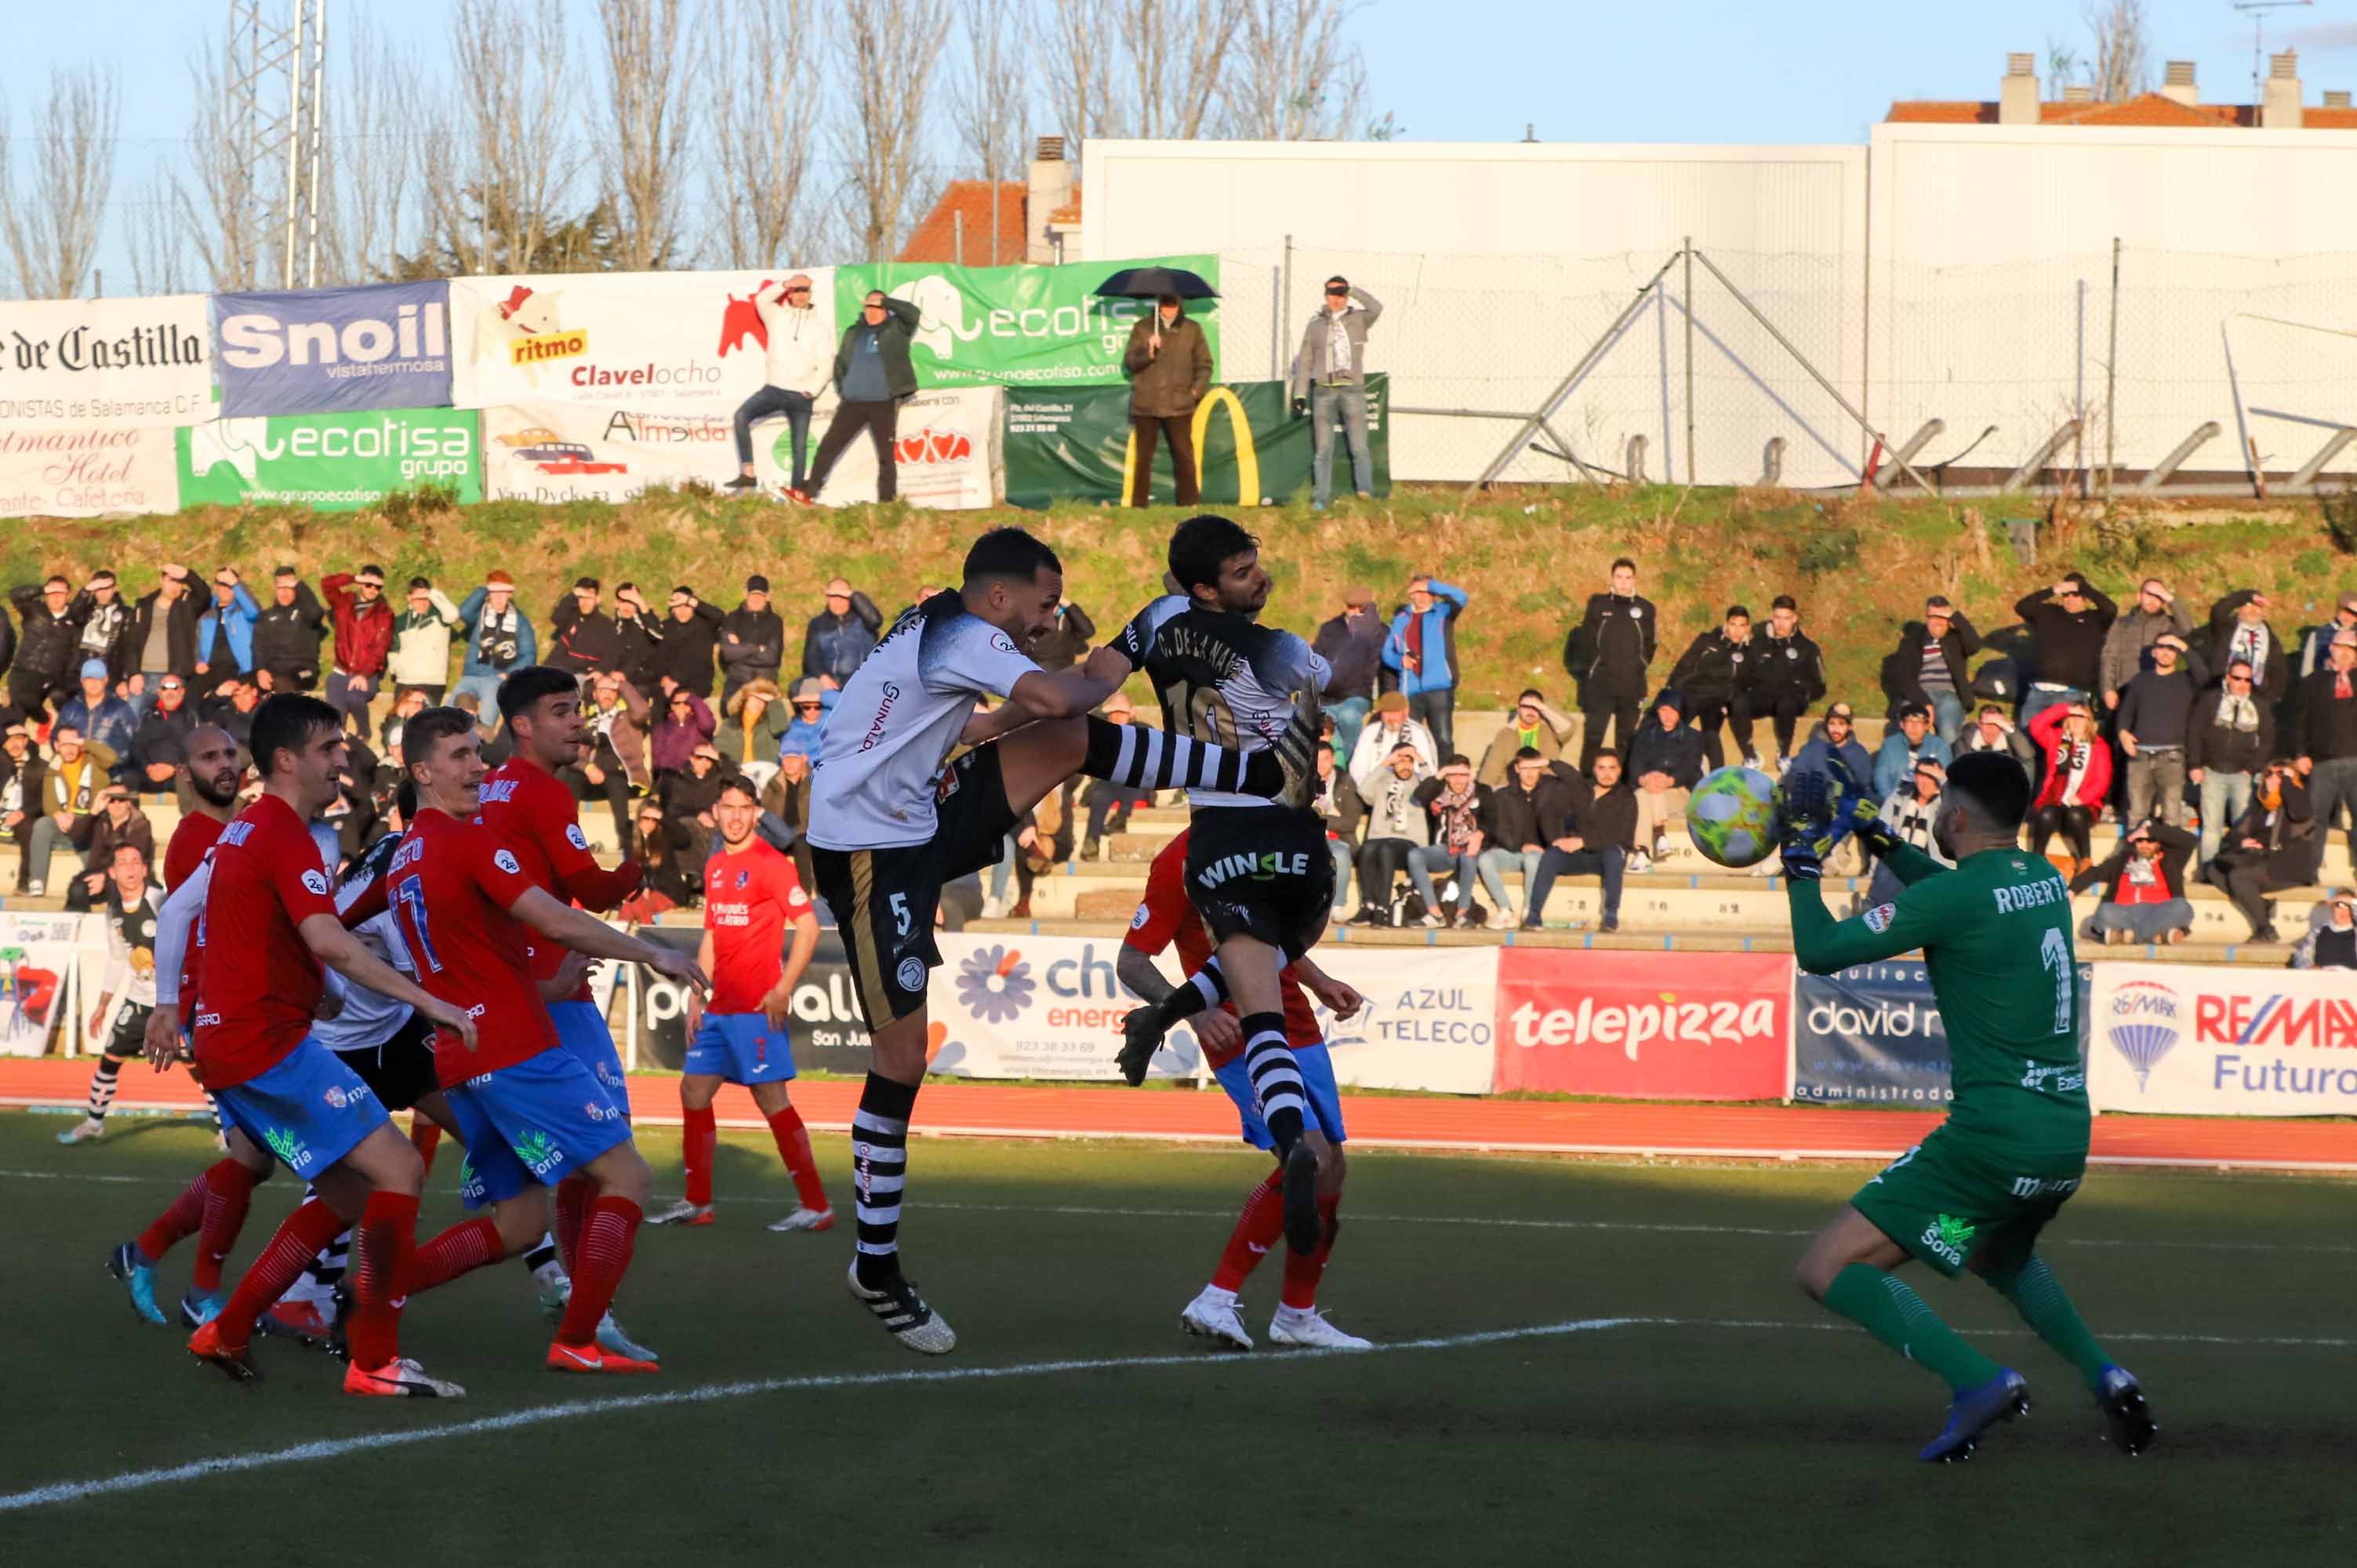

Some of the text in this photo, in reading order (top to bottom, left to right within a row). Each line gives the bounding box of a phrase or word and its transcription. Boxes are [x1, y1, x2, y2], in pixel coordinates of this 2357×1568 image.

[11, 323, 204, 372] de Castilla
[221, 302, 445, 369] Snoil
[516, 336, 583, 363] ritmo
[326, 360, 445, 379] vistahermosa
[571, 359, 722, 387] Clavelocho
[69, 400, 86, 418] de
[91, 398, 171, 418] Salamanca
[291, 420, 470, 457] ecotisa
[602, 410, 728, 443] Almeida
[42, 451, 135, 486] Hotel
[400, 459, 468, 480] grupo
[858, 681, 900, 753] GUINALD
[889, 891, 912, 936] 5
[2041, 927, 2072, 1034] 1
[1396, 989, 1473, 1011] AZUL
[1048, 1006, 1131, 1035] energ
[1376, 1021, 1491, 1046] TELECO
[1510, 993, 1775, 1062] telepizza
[1807, 1000, 1916, 1037] david
[754, 1037, 766, 1061] 7
[812, 1029, 841, 1047] San
[2213, 1054, 2357, 1097] Futuro
[1921, 1228, 1963, 1267] Soria
